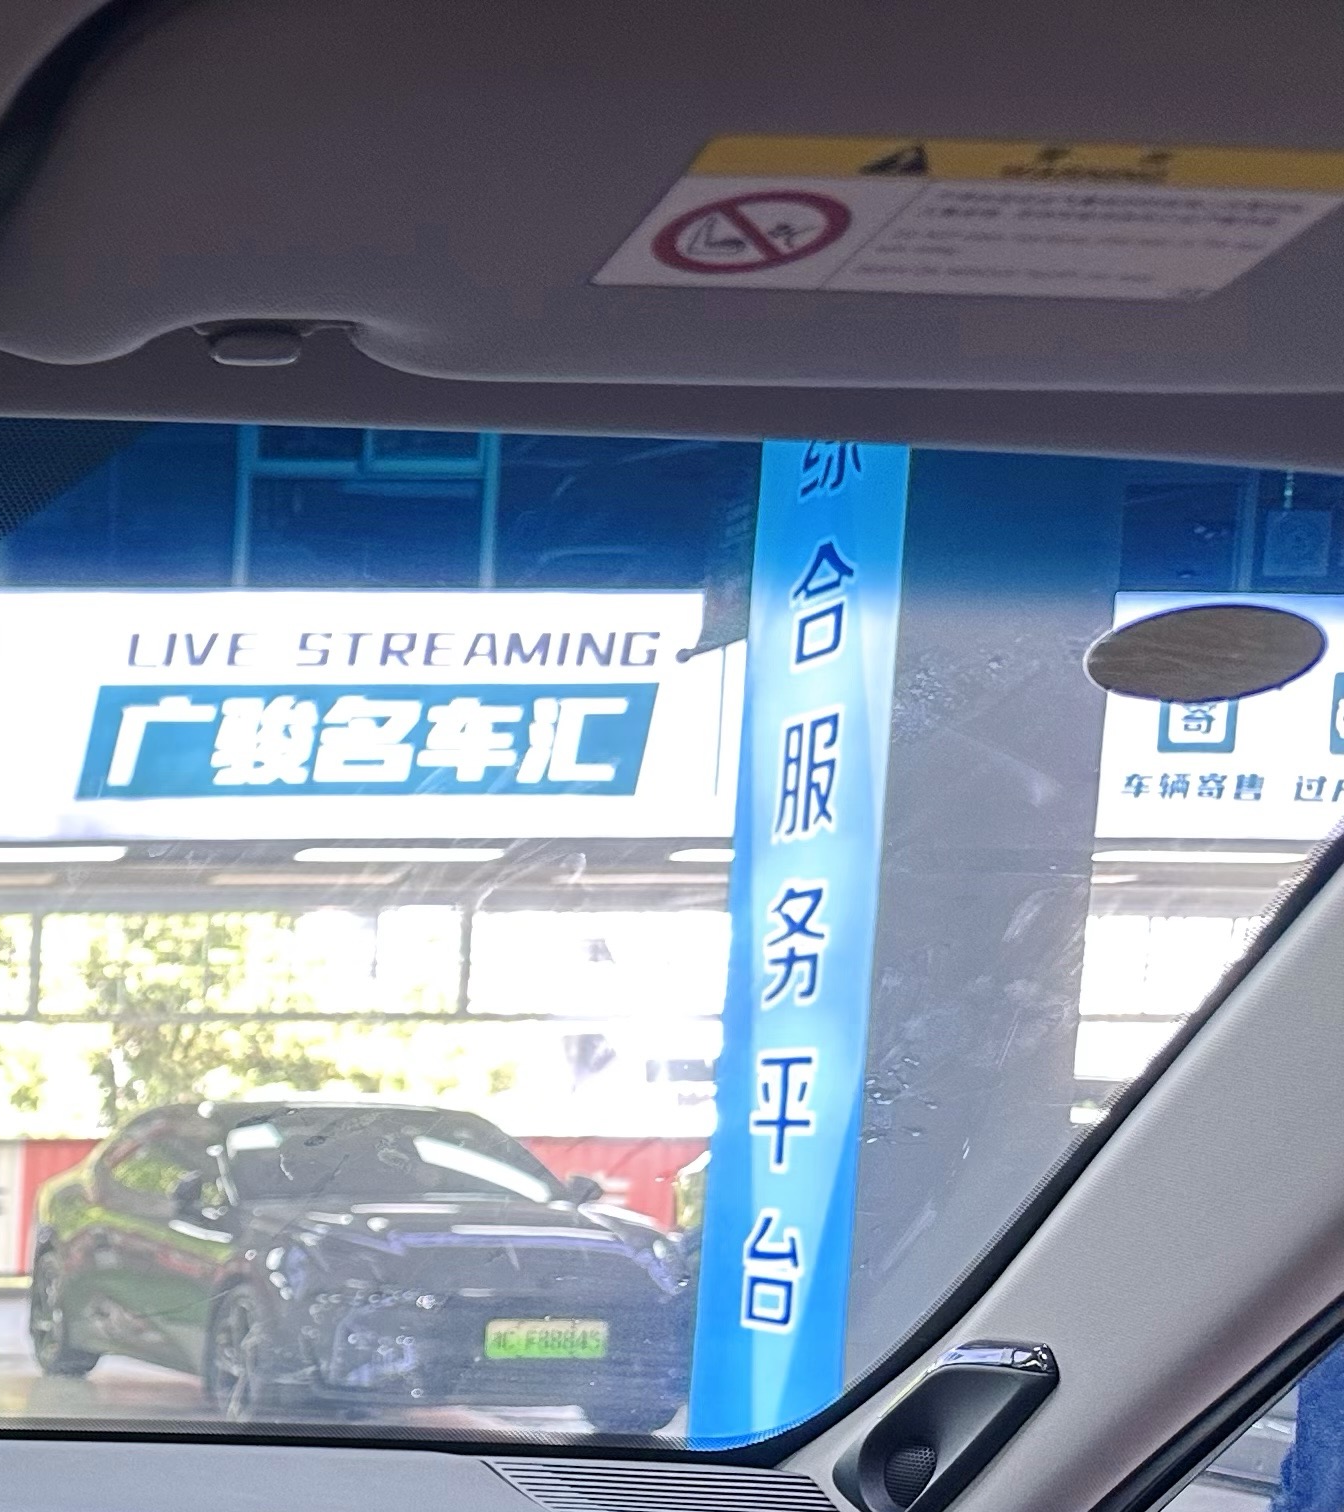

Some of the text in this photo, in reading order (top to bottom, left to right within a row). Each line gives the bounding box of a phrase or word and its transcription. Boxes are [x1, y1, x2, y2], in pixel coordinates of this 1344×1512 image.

[127, 630, 662, 669] LIVE STREAMING
[106, 694, 631, 787] 广骏名车汇
[1121, 772, 1265, 802] 车辆寄售
